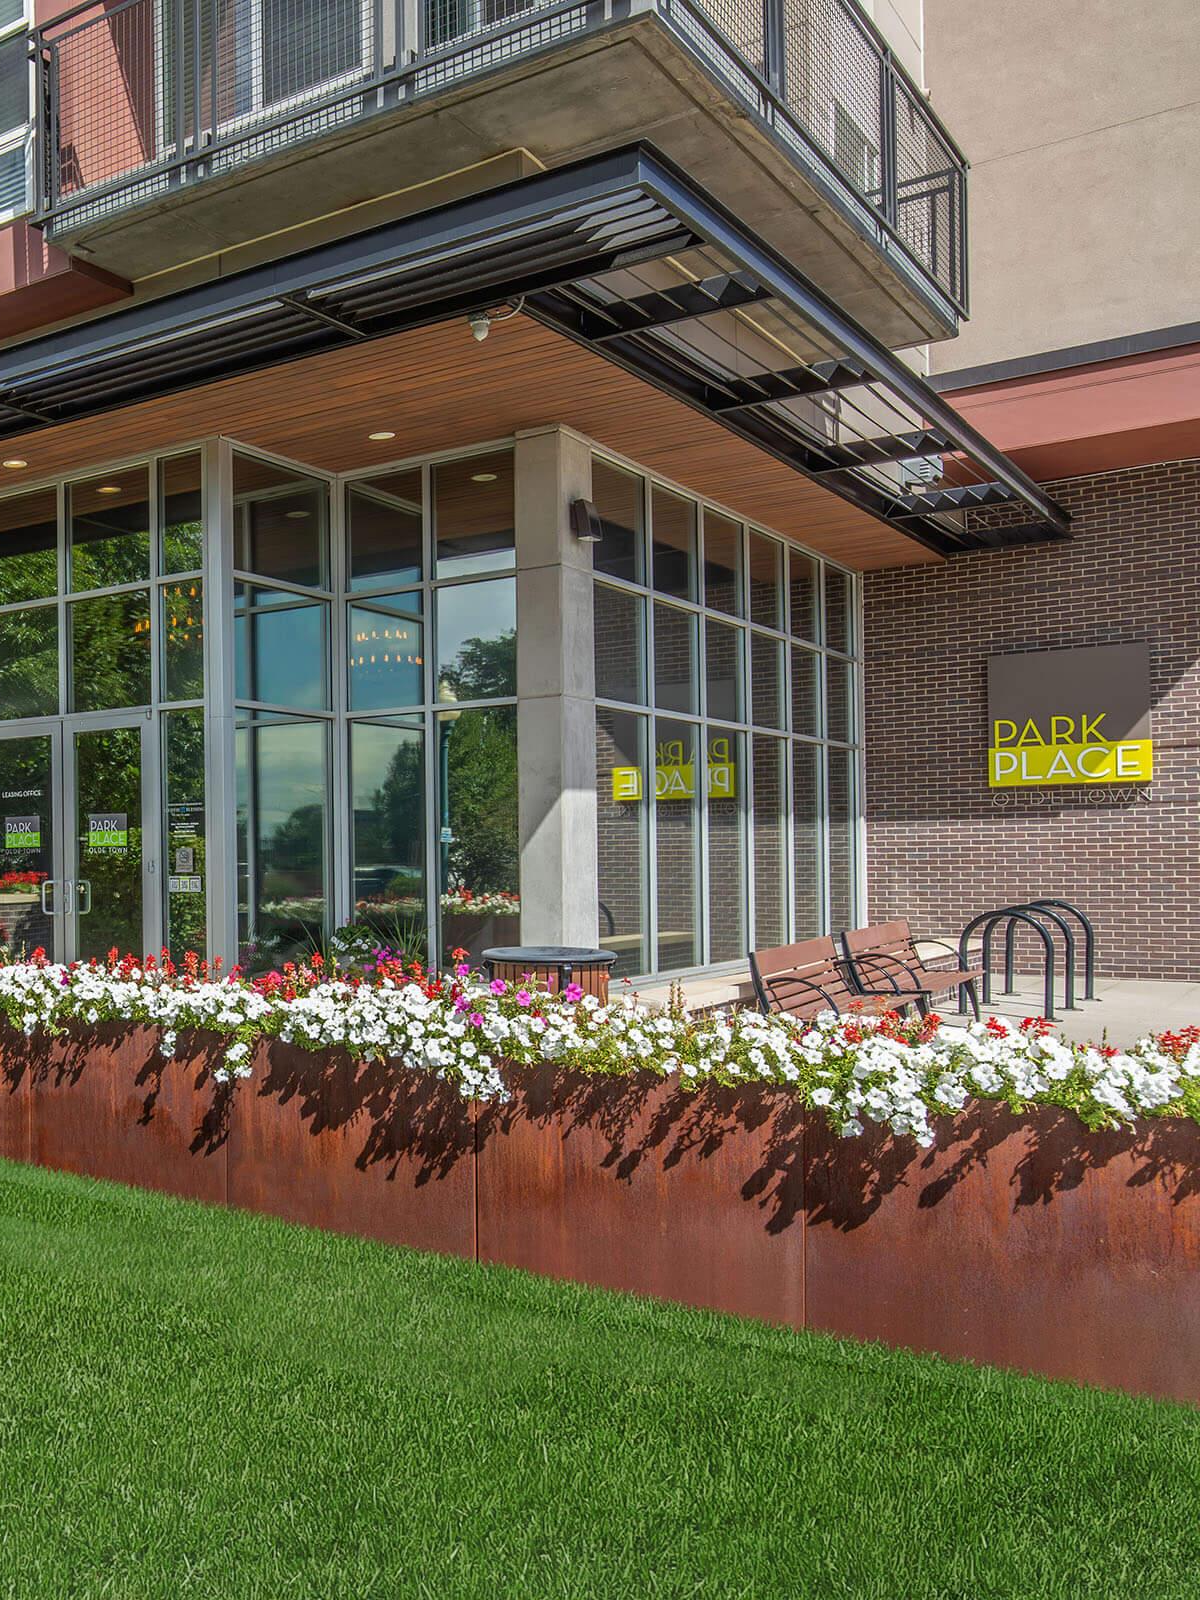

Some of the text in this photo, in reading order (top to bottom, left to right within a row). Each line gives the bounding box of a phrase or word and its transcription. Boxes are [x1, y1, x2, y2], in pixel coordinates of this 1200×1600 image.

[993, 712, 1107, 749] PARK
[994, 744, 1143, 782] PLACE
[1, 790, 22, 799] LEASING
[6, 822, 32, 834] PARK
[90, 819, 118, 832] PARK
[6, 832, 39, 846] PLACE
[90, 832, 125, 845] PLACE
[4, 848, 21, 856] OLDE
[88, 846, 128, 855] OLDE TOWN
